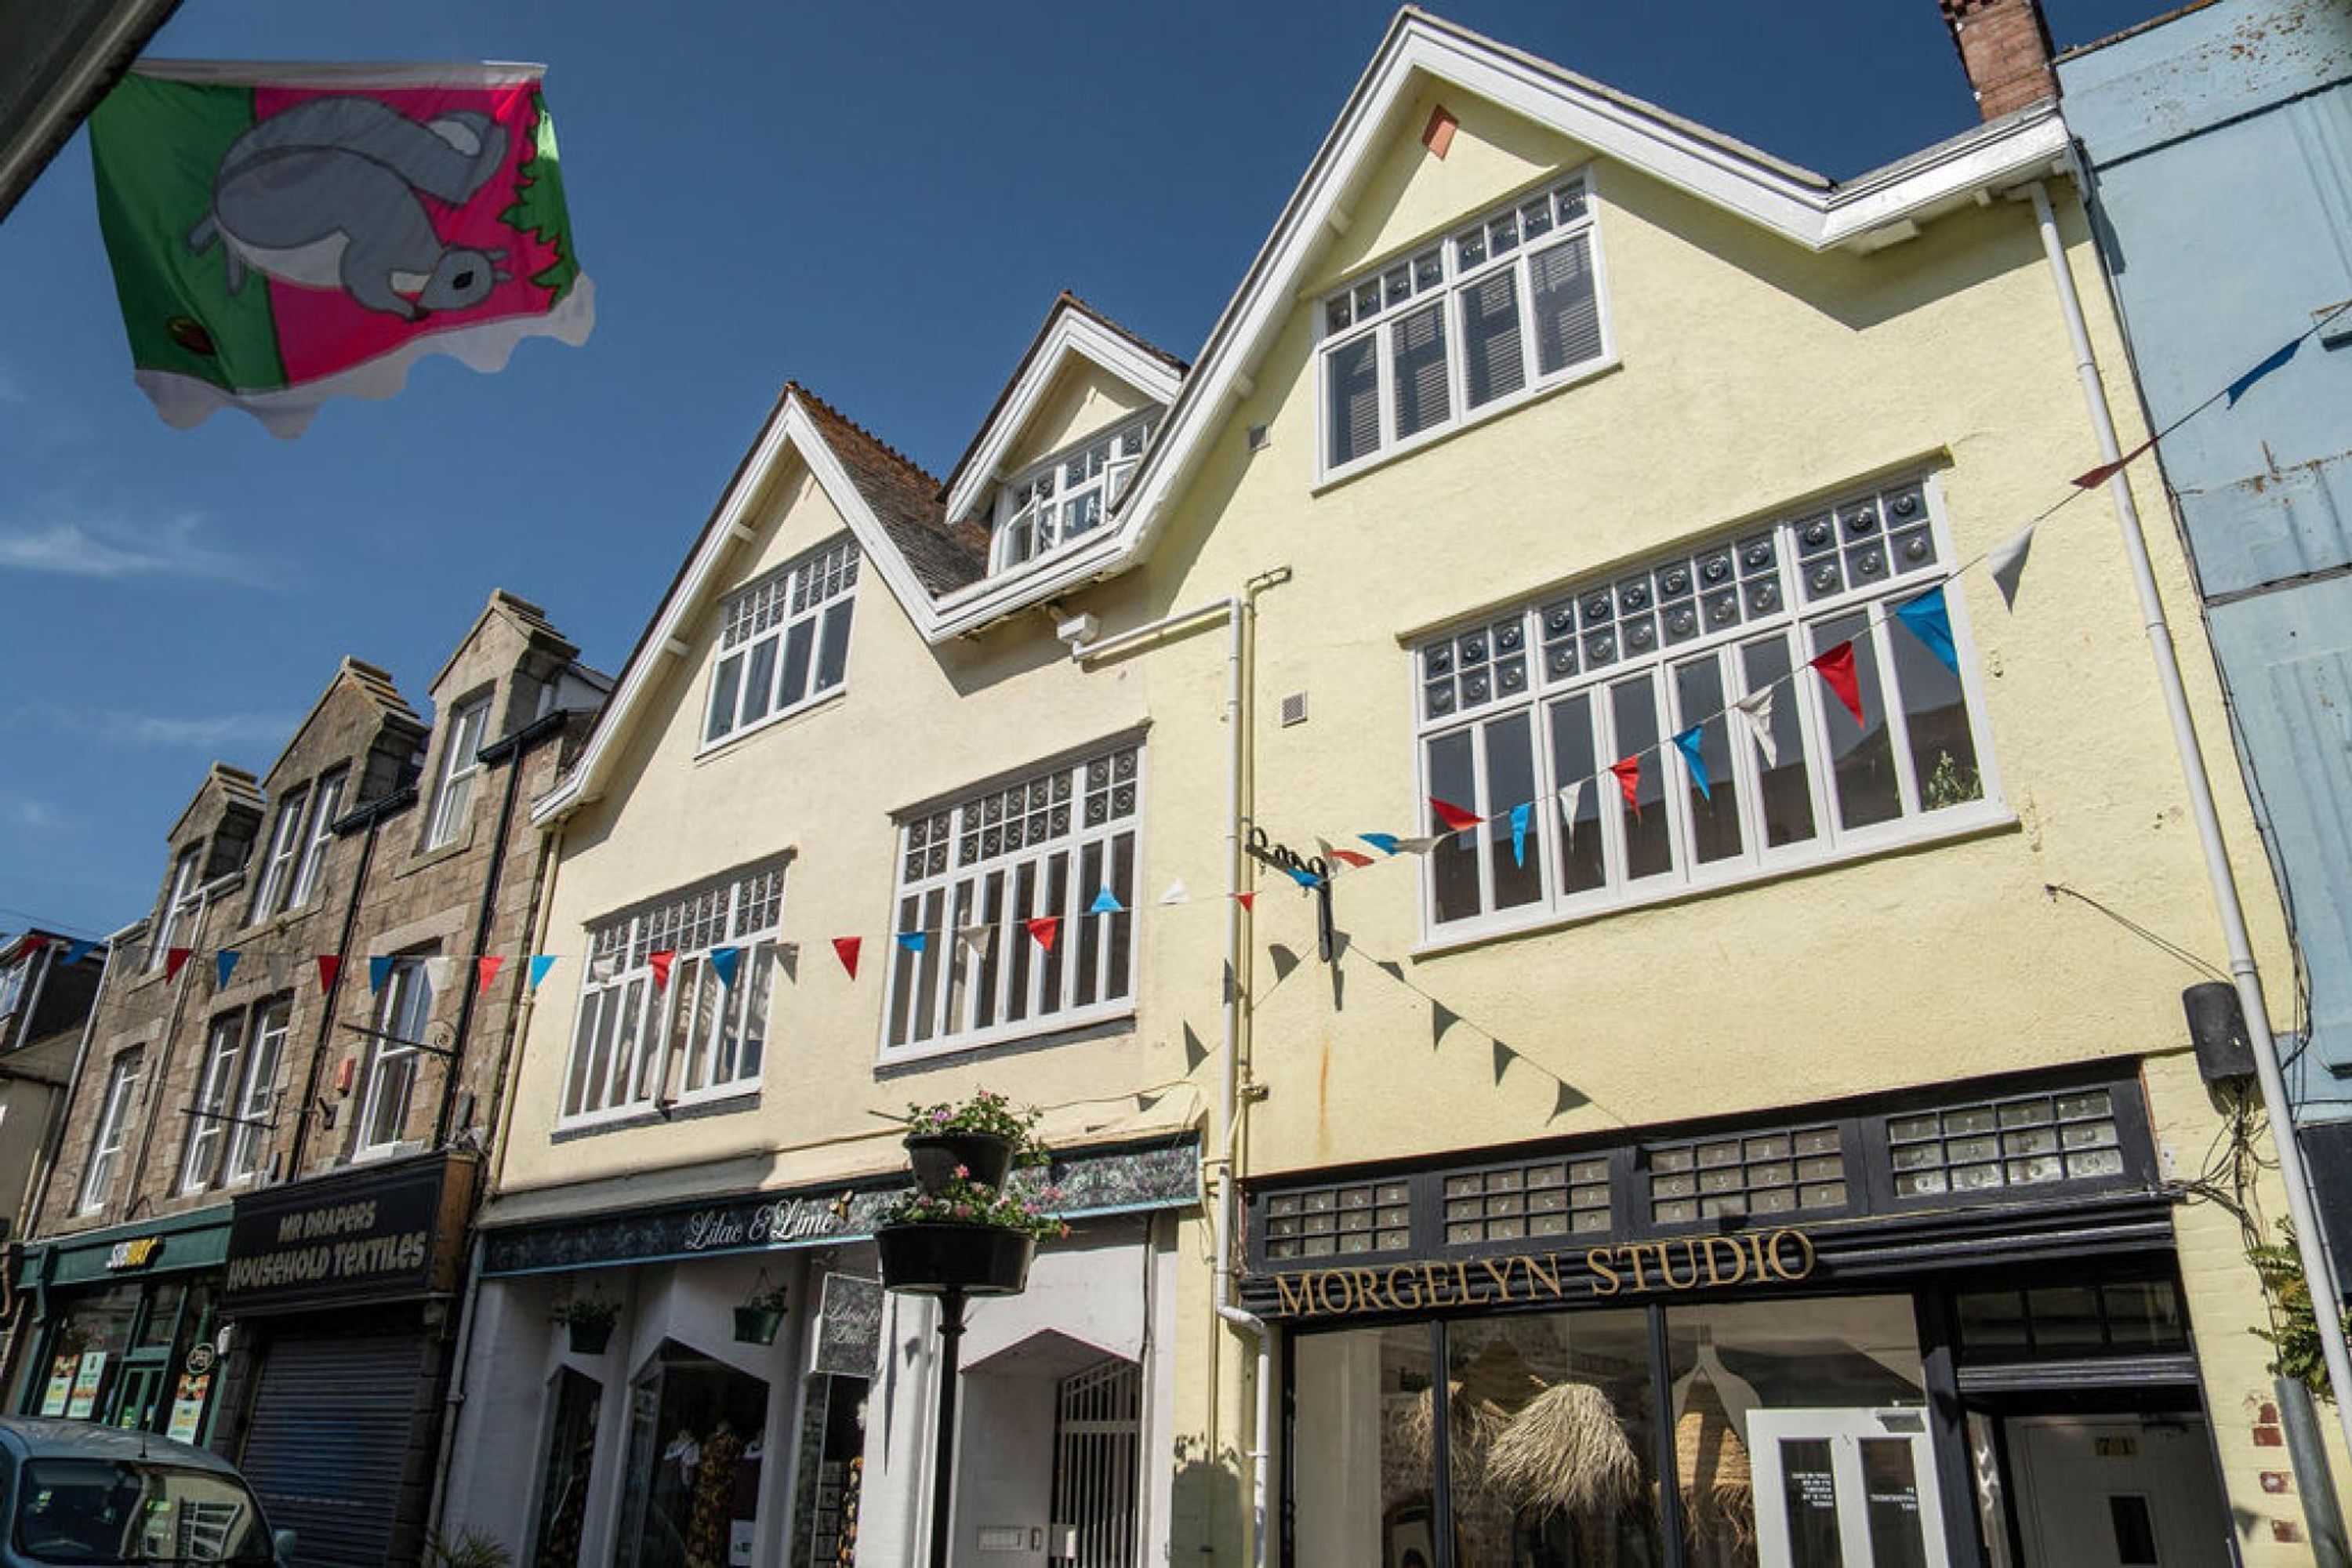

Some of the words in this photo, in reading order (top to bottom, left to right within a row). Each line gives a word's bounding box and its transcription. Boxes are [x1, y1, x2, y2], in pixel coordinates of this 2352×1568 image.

[278, 1214, 305, 1243] MR
[684, 1209, 743, 1250] Lilac
[749, 1203, 772, 1241] &
[769, 1198, 835, 1240] Lime
[1274, 1253, 1563, 1316] MORGELYN
[1586, 1229, 1817, 1295] STUDIO
